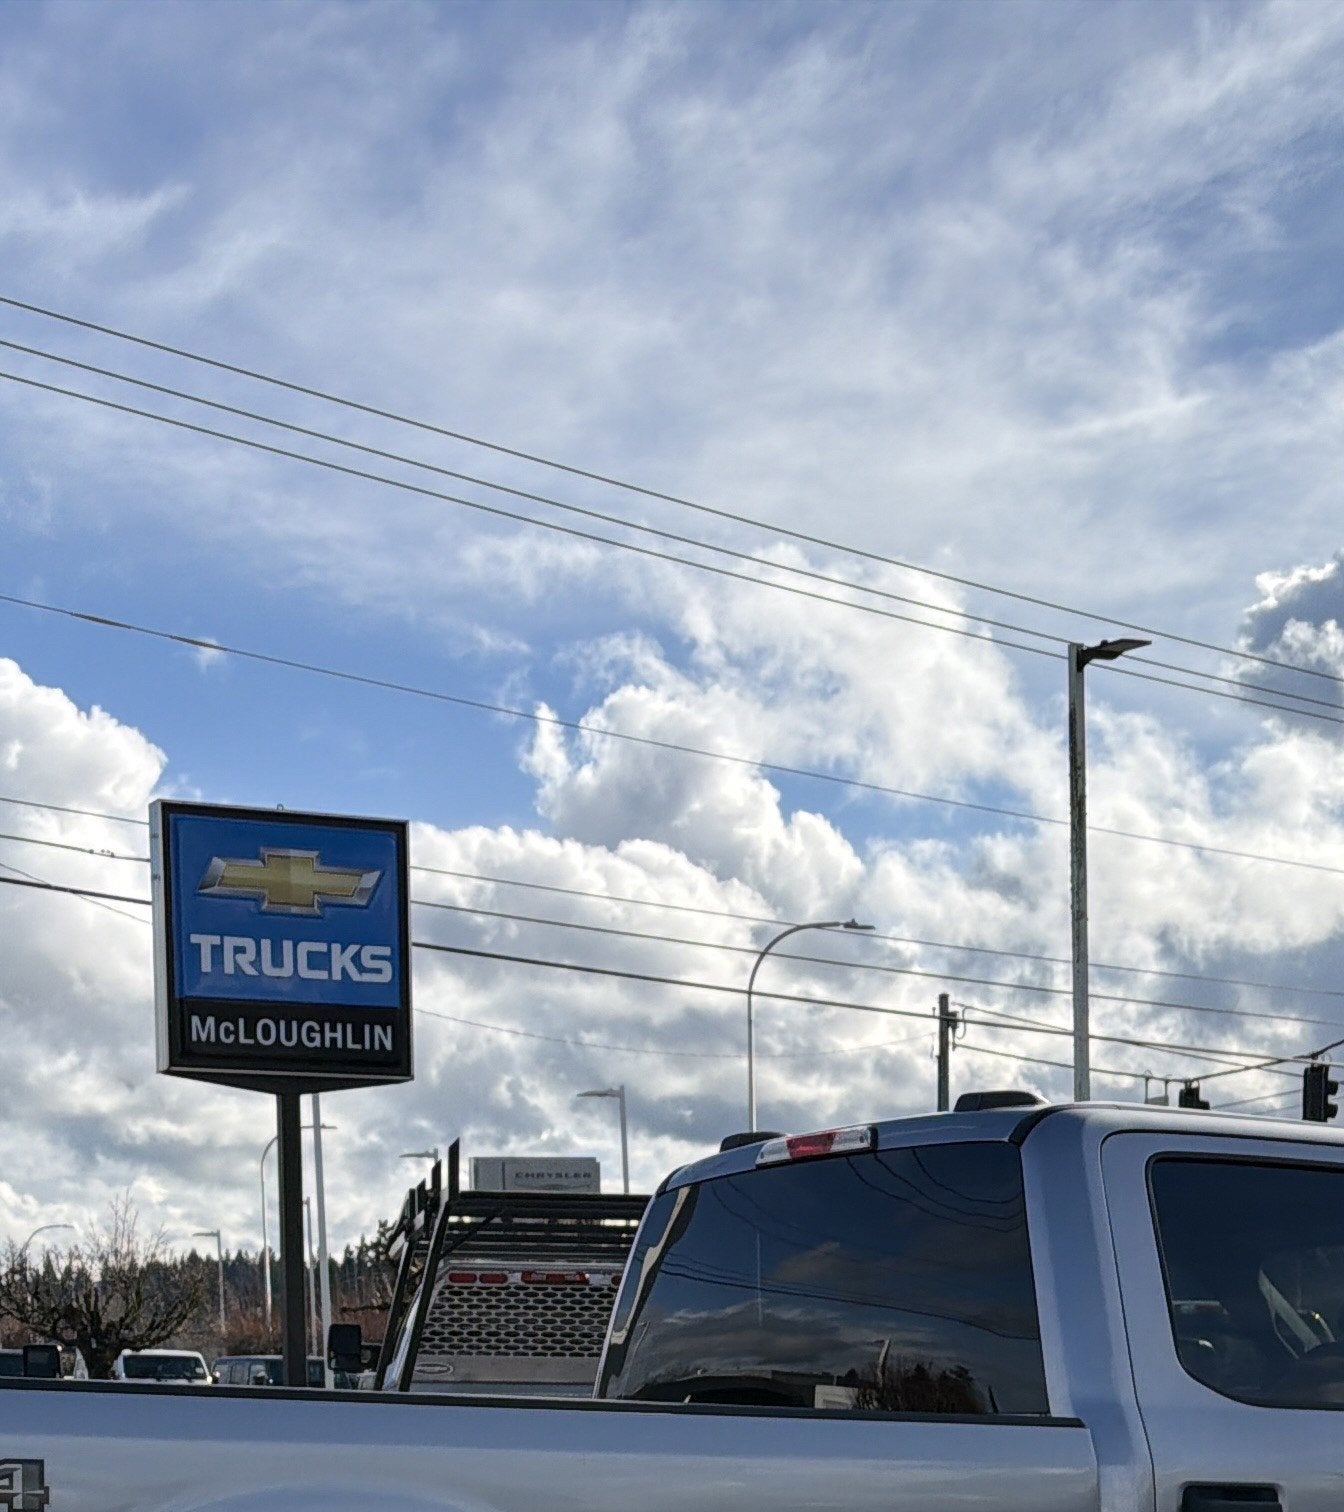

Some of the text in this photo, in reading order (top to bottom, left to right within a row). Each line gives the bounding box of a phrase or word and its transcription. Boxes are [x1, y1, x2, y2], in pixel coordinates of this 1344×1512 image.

[190, 933, 393, 983] TRUCKS
[190, 1014, 394, 1051] McLOUGHLIN
[515, 1171, 592, 1179] CHRYSLER
